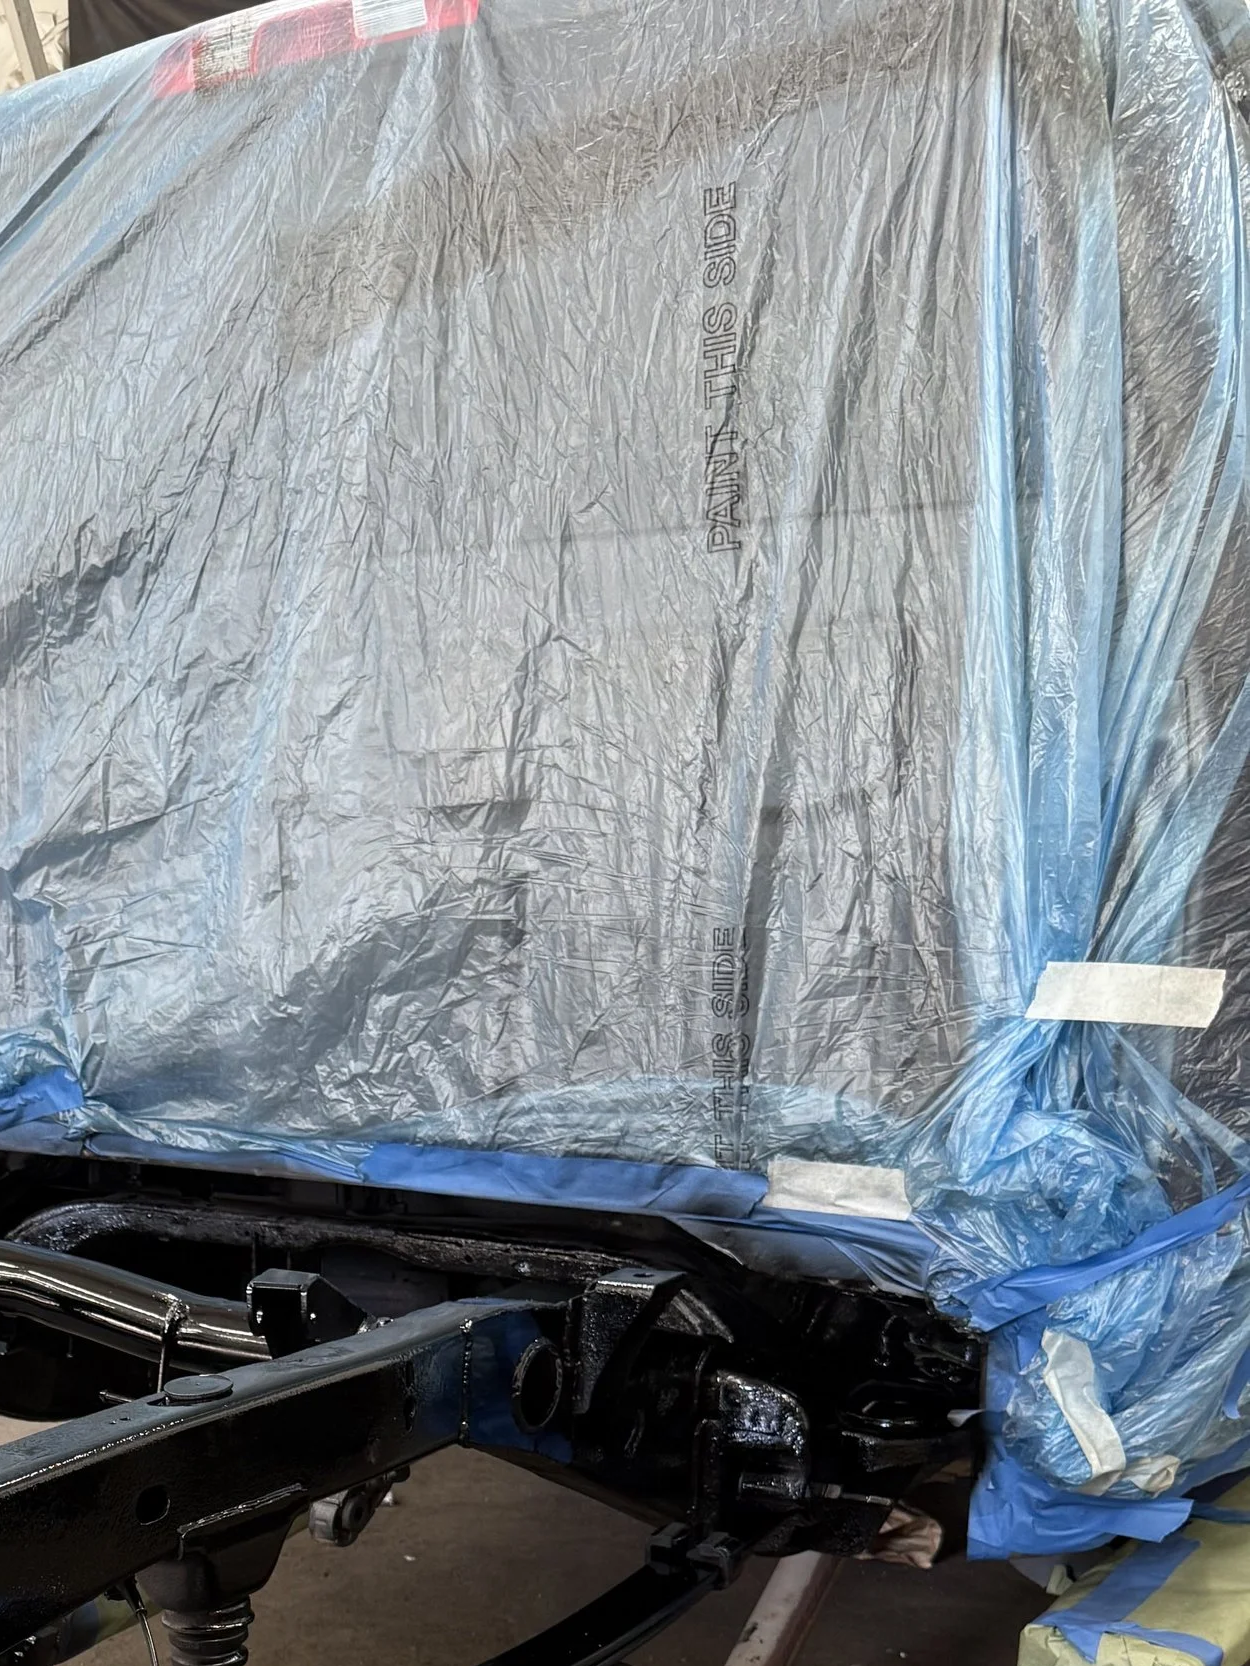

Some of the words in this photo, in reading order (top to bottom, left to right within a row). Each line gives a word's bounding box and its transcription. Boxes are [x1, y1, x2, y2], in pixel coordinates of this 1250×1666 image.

[703, 181, 737, 289] SIDE
[702, 302, 738, 410] THIS
[706, 425, 741, 553] PAINT
